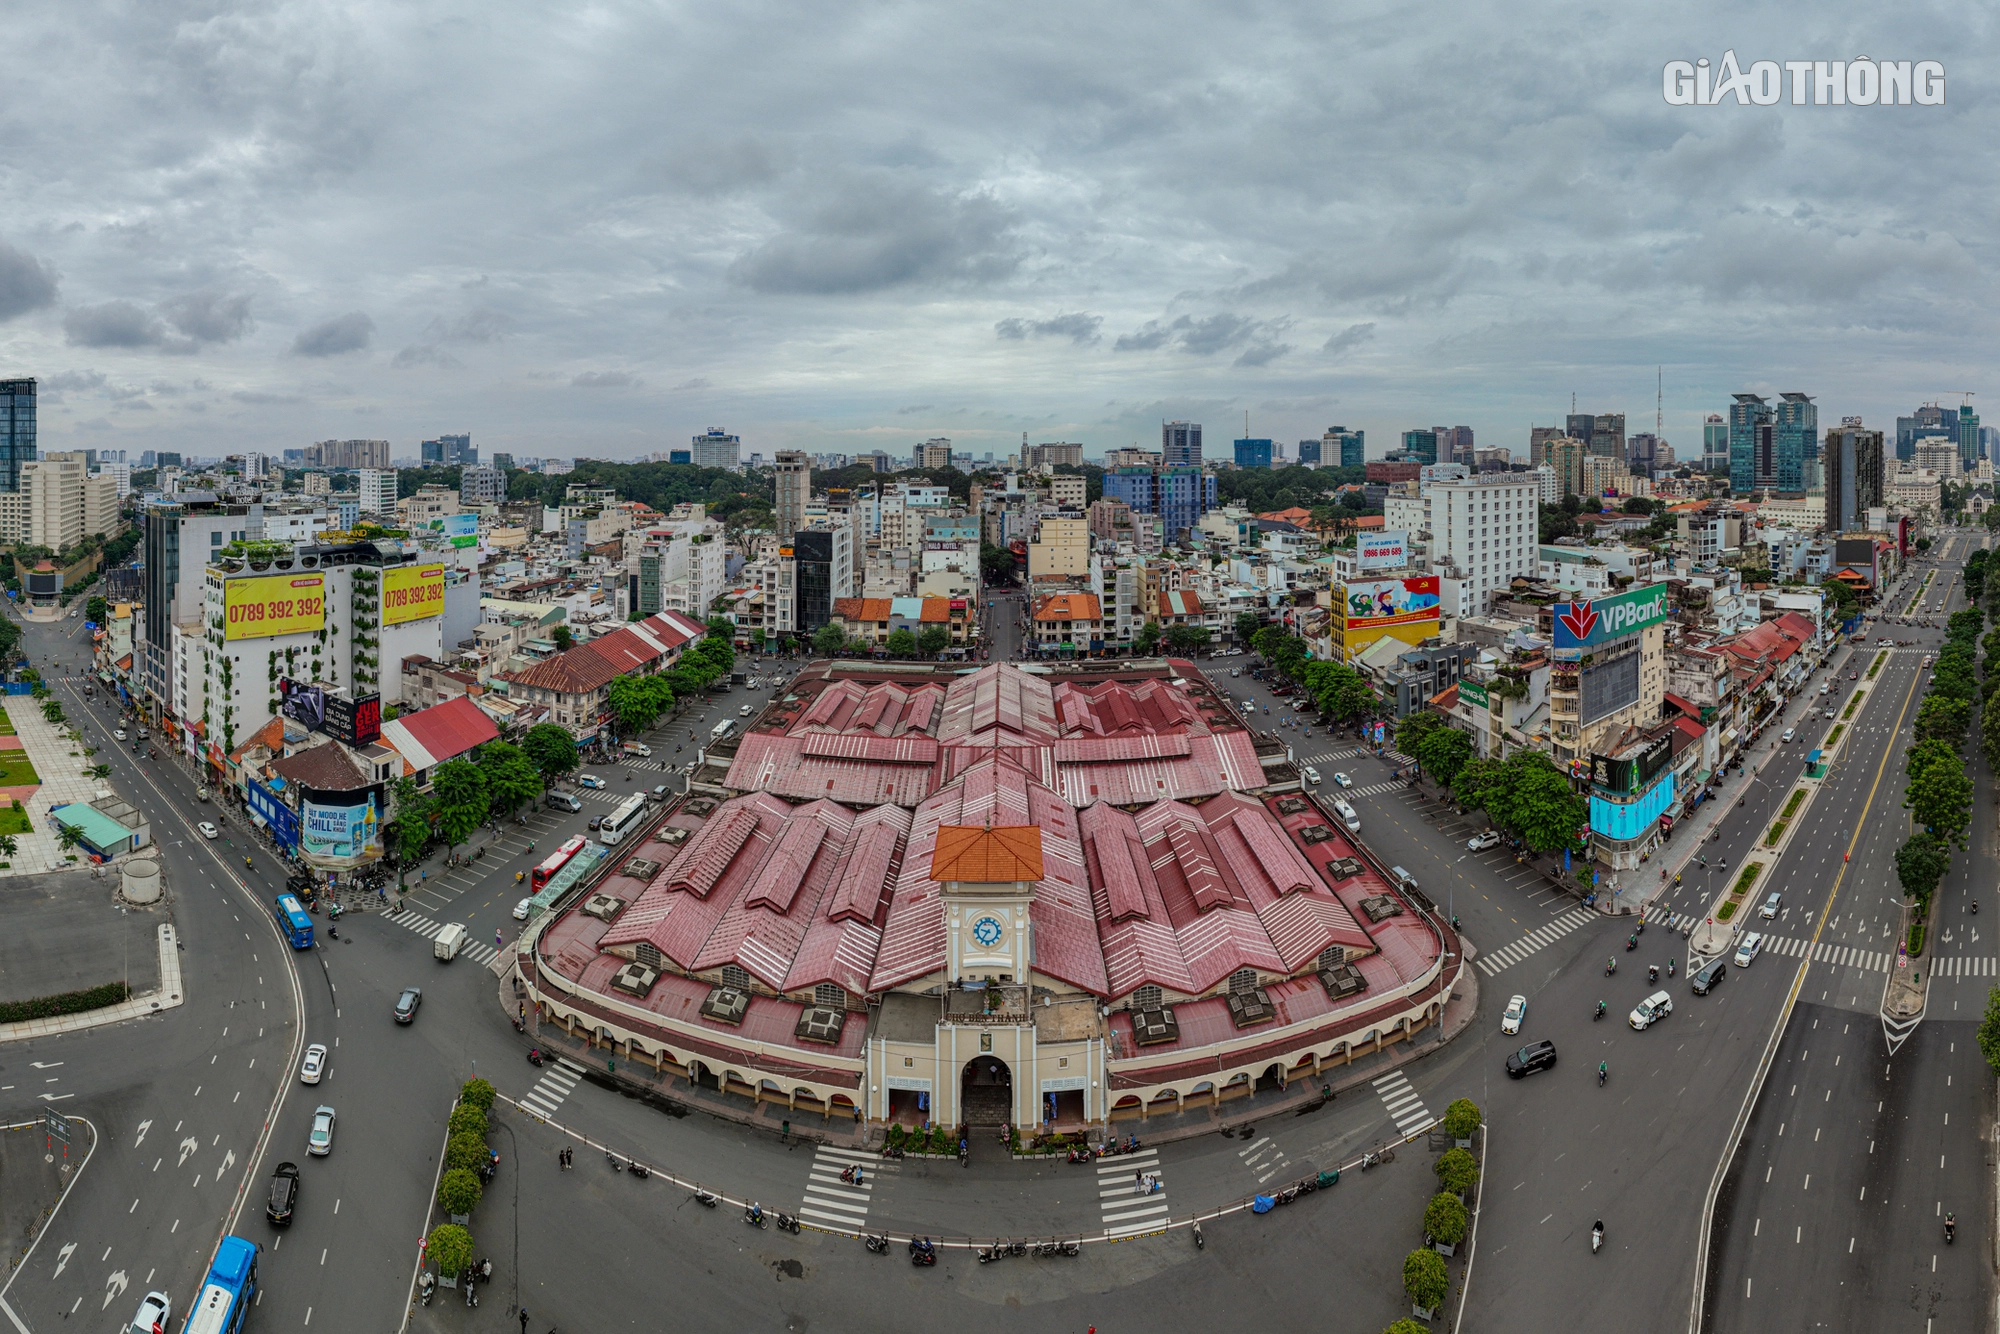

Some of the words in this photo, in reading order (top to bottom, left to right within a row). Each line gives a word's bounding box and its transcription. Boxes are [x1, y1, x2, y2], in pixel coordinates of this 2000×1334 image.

[1364, 549, 1378, 557] 0986
[1379, 548, 1390, 556] 669
[1391, 547, 1402, 555] 689
[385, 588, 407, 608] 0789
[409, 585, 425, 604] 392
[427, 583, 442, 601] 392
[229, 603, 265, 623] 0789
[268, 600, 293, 619] 392
[297, 597, 321, 616] 392
[1601, 593, 1664, 633] VPBank
[1416, 672, 1436, 680] Amazon
[359, 700, 378, 714] JUN
[355, 710, 379, 727] GER
[318, 810, 338, 819] MOOD
[308, 816, 331, 832] CHILL
